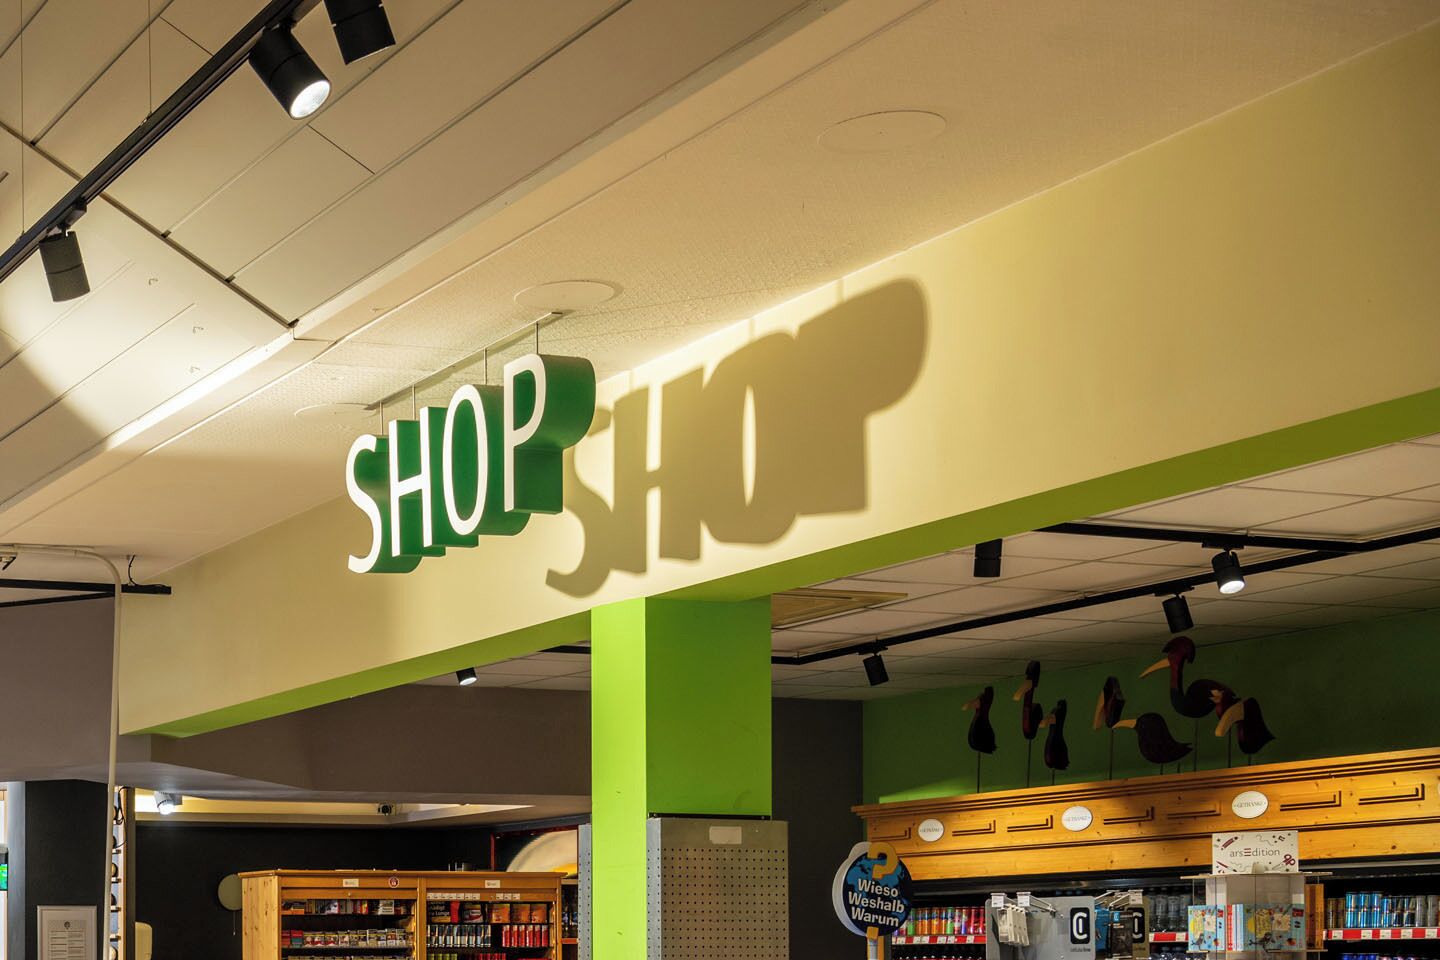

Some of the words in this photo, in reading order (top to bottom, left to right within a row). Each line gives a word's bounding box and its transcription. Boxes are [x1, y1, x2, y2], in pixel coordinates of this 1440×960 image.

[345, 354, 550, 574] SHOP
[858, 878, 899, 897] Wieso
[848, 891, 905, 913] Weshalb
[851, 906, 899, 927] Warum
